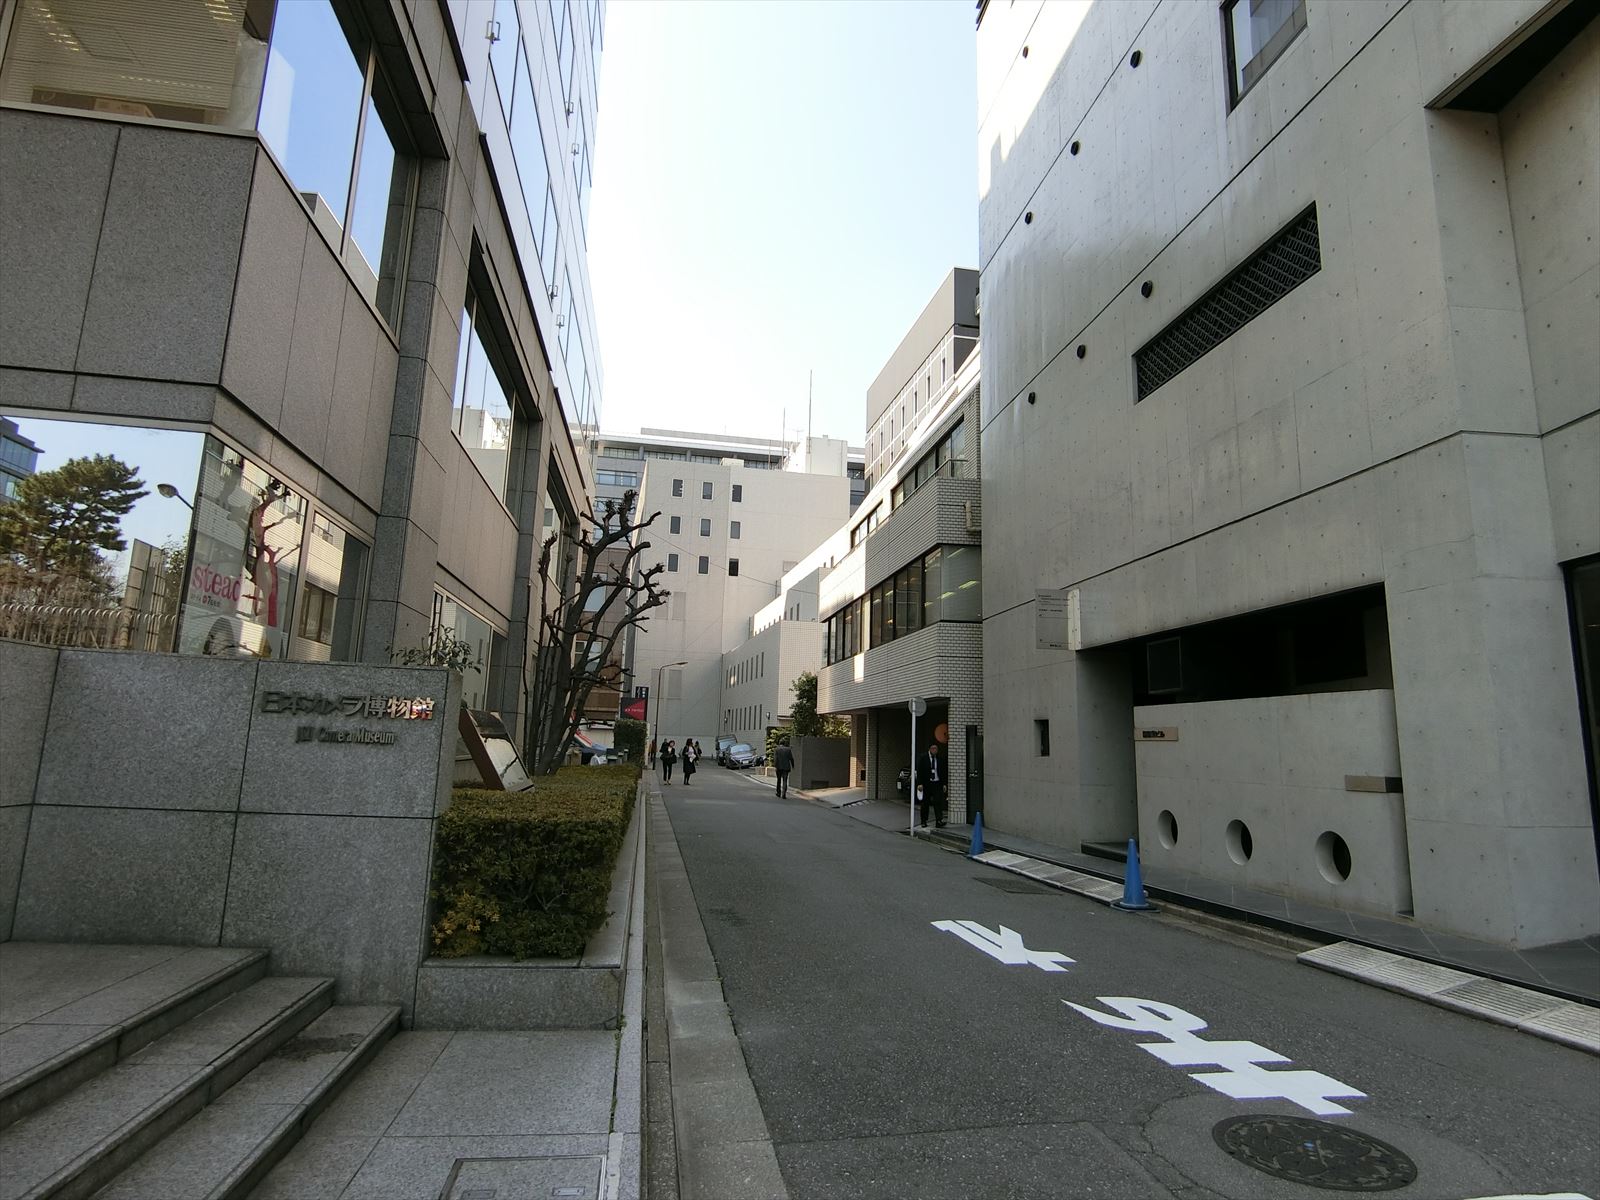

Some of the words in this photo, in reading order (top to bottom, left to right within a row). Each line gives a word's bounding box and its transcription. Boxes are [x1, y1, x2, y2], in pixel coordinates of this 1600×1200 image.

[262, 690, 435, 720] 日本カメラ博物館
[353, 727, 395, 745] Museum
